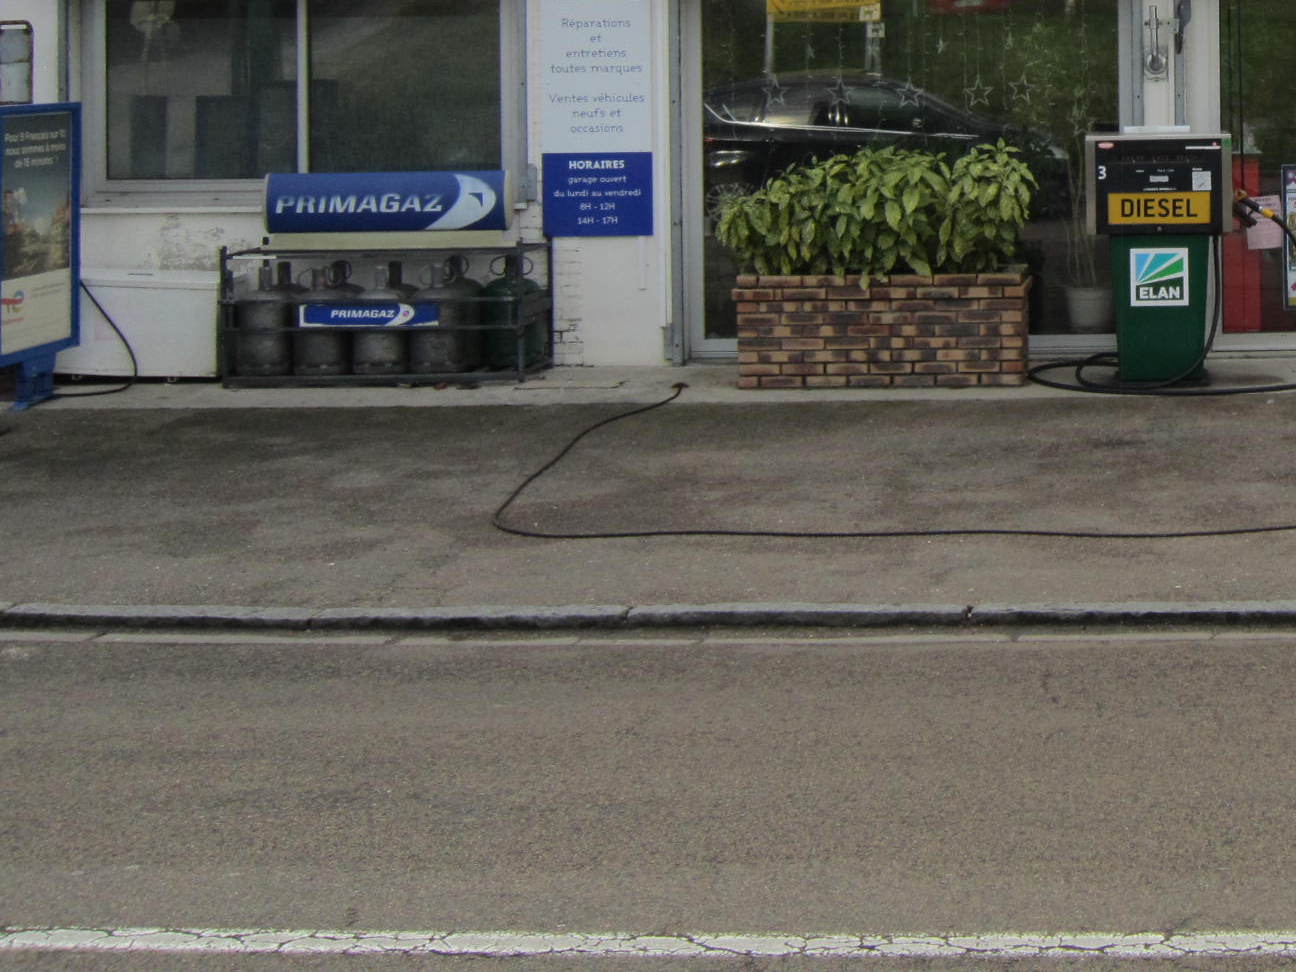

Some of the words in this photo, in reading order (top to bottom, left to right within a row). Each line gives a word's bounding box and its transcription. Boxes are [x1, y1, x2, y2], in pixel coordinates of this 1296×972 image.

[560, 18, 632, 30] Réparations
[590, 33, 603, 43] et
[566, 48, 627, 59] entretiens
[550, 64, 587, 74] toutes
[591, 64, 643, 75] marques
[549, 93, 589, 103] Ventes
[592, 93, 646, 103] véhicules
[572, 108, 606, 118] neufs
[609, 108, 622, 117] et
[570, 124, 624, 134] occasions
[568, 159, 625, 170] HORAIRES
[1097, 166, 1107, 180] 3
[568, 177, 597, 185] garage
[600, 175, 627, 183] ouvert
[605, 189, 642, 197] vendredi
[275, 192, 444, 214] PRIMAGAZ
[600, 202, 616, 210] 12H
[1120, 199, 1198, 218] DIESEL
[577, 217, 594, 225] 14H
[602, 216, 618, 224] 17H
[1139, 286, 1180, 300] ELAN
[330, 308, 395, 319] PRIMAGAZ
